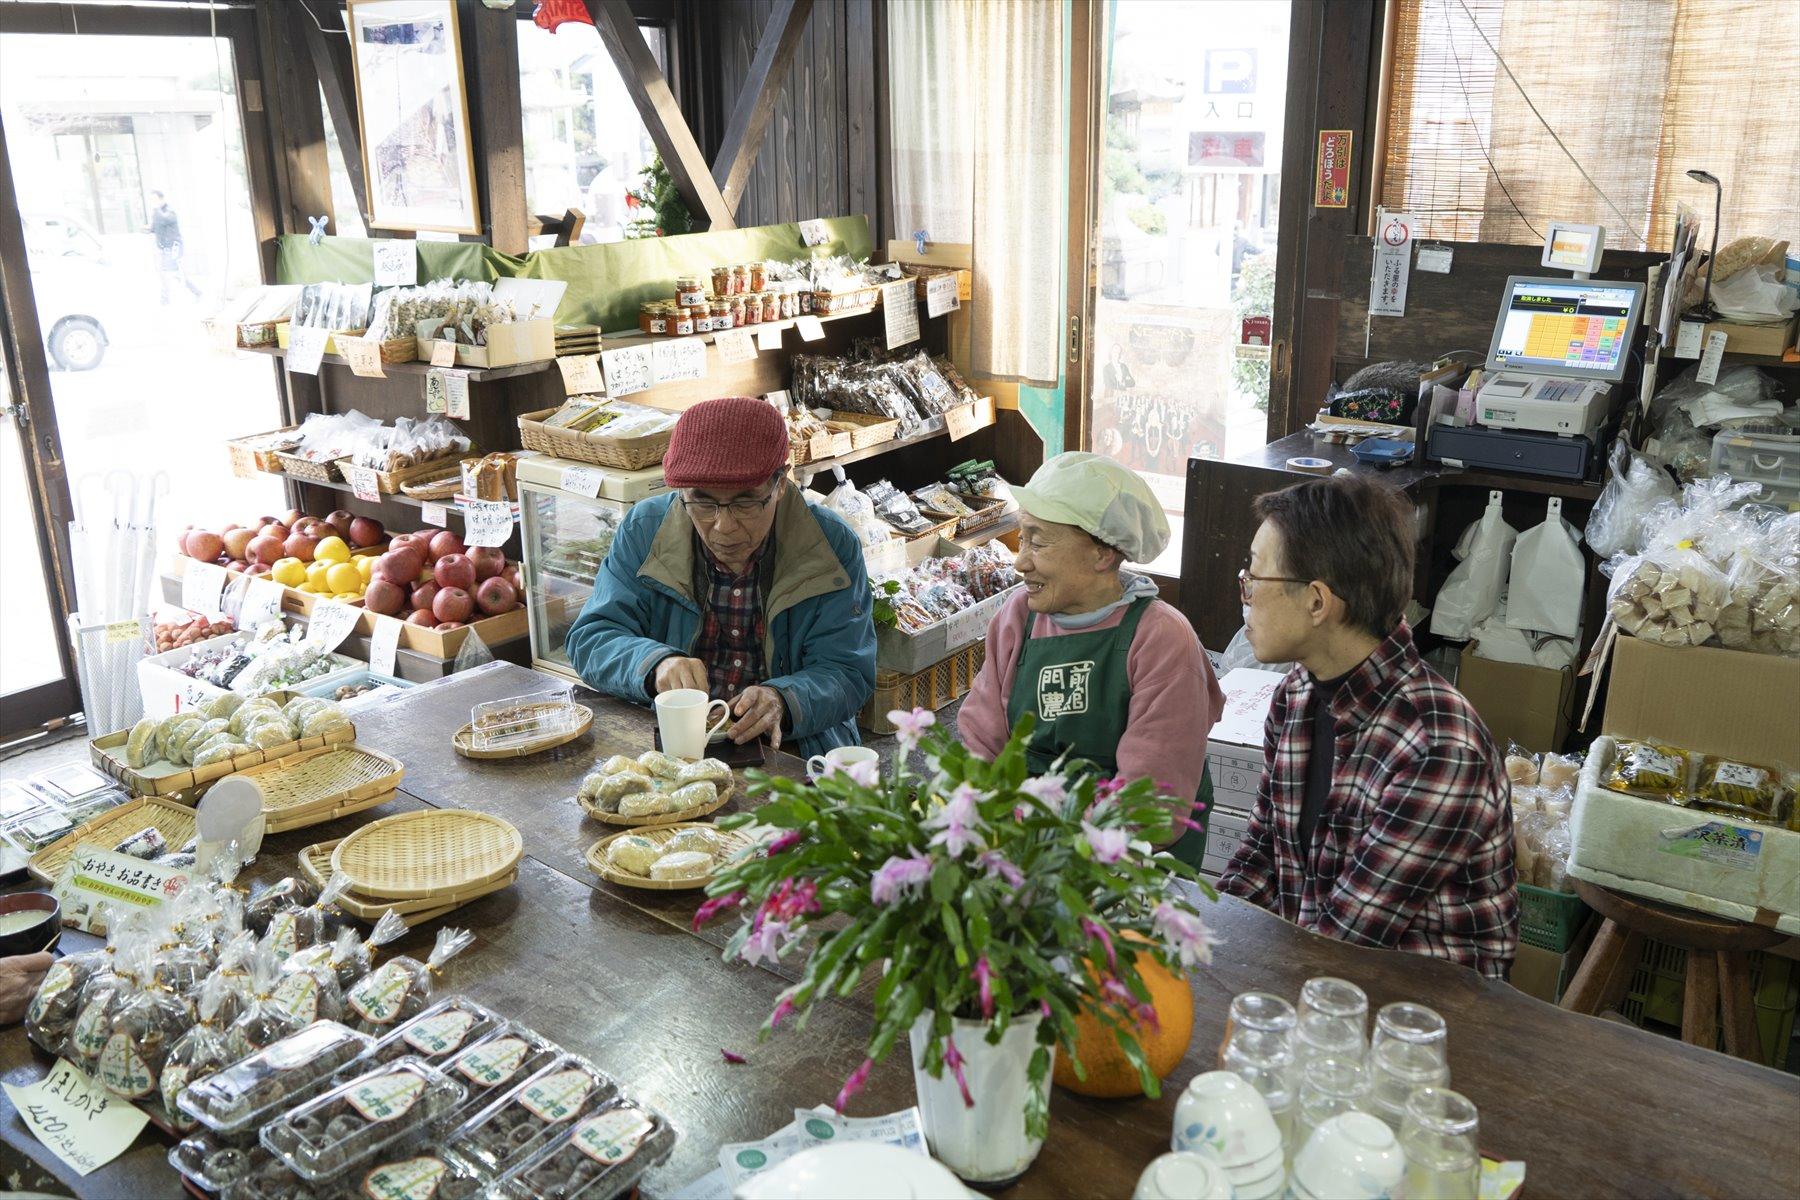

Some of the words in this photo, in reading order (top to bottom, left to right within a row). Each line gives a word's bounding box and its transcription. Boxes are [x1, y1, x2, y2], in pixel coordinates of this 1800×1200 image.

[1209, 50, 1252, 92] P
[1204, 101, 1253, 118] 入口
[1391, 259, 1401, 303] ふる里の幸を
[83, 858, 116, 878] おやき
[116, 868, 162, 891] お品書き
[41, 1071, 109, 1120] ほしがき
[102, 1071, 149, 1089] ほしがき
